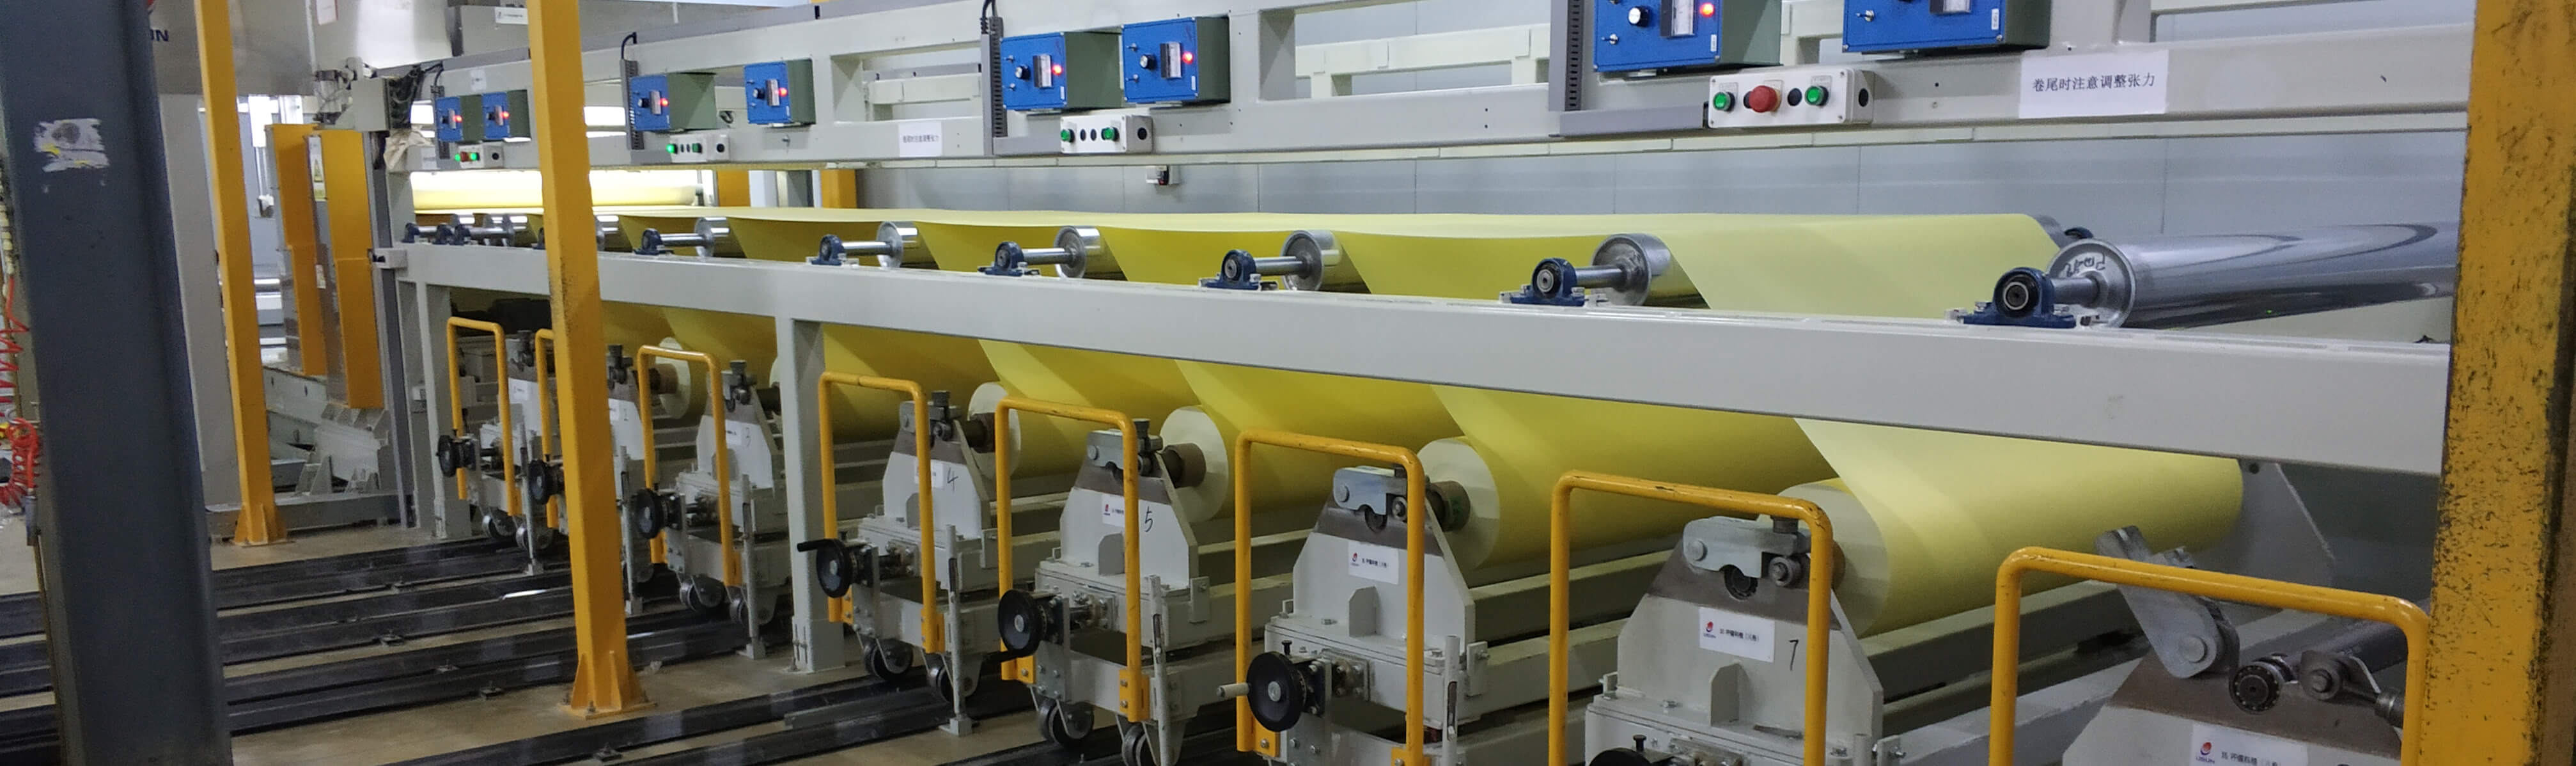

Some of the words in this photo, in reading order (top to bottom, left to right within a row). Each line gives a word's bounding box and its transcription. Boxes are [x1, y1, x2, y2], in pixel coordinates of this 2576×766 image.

[2033, 72, 2155, 91] 卷尾时注意调整张力
[947, 467, 958, 494] 4
[1144, 506, 1153, 532] 5
[1789, 639, 1799, 671] 7
